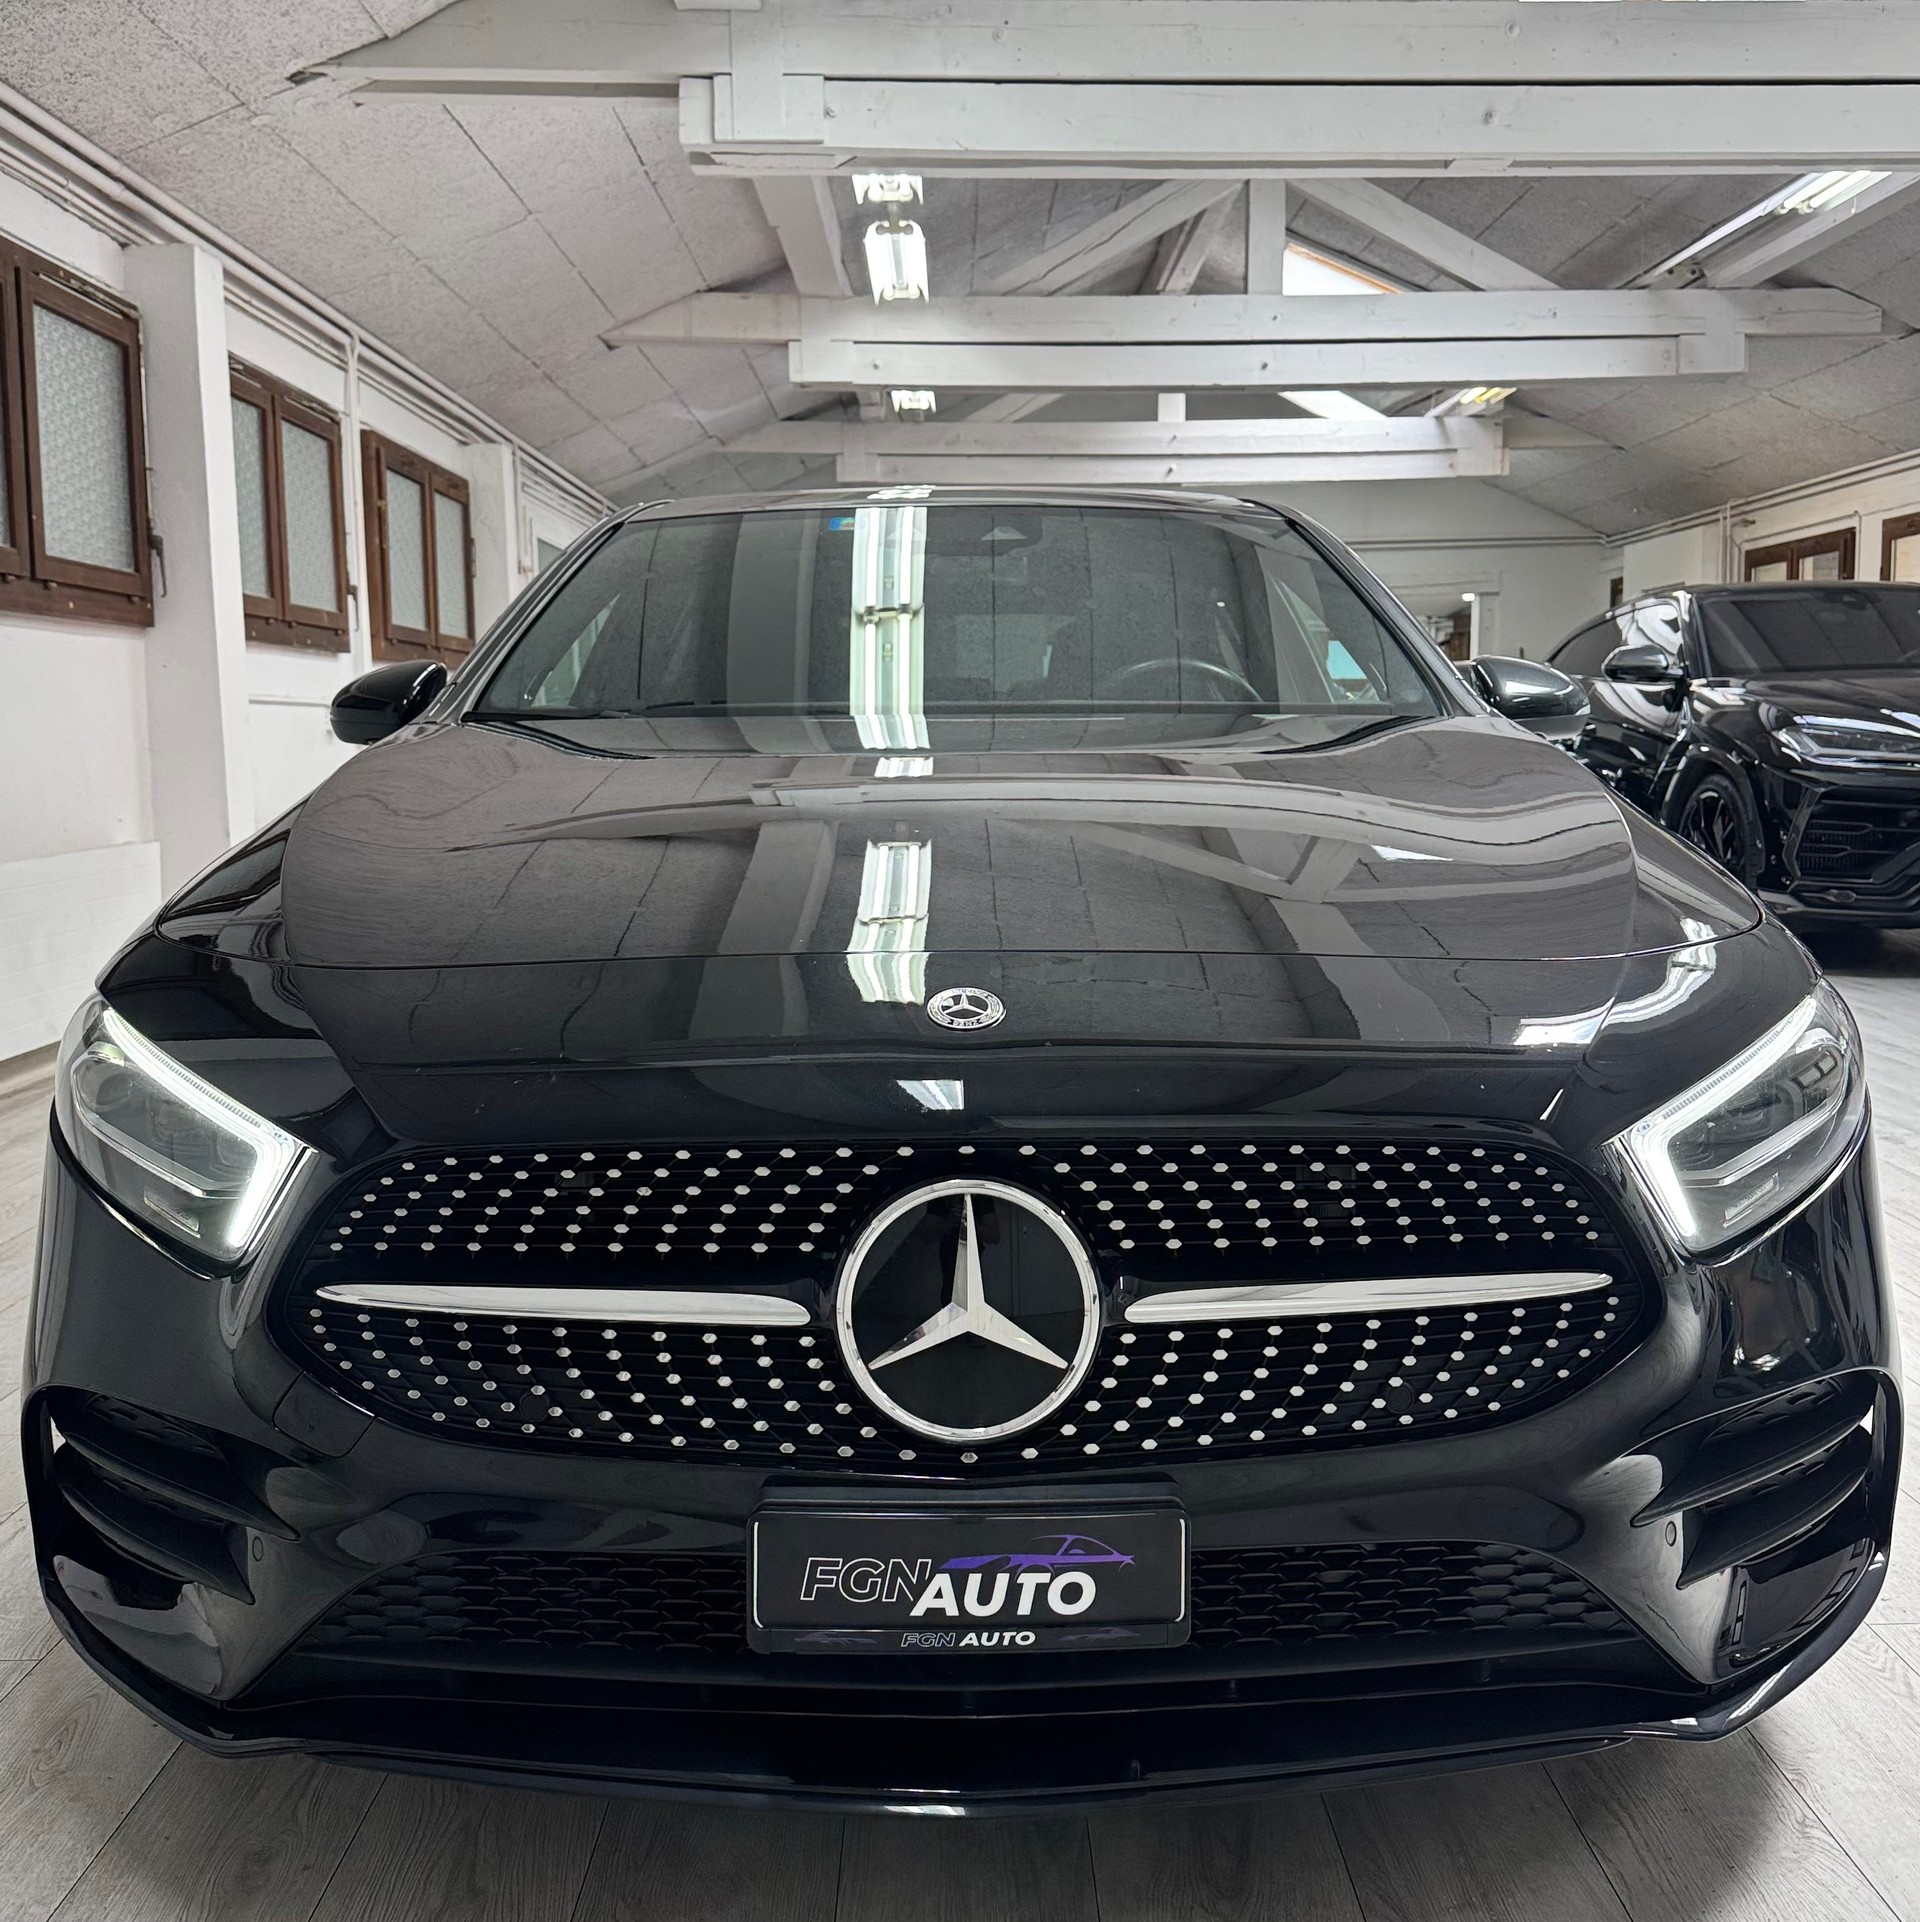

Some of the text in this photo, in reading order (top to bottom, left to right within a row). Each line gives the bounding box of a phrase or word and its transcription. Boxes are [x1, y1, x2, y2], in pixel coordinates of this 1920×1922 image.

[800, 1557, 1097, 1617] FGN AUTO
[901, 1631, 1036, 1647] FGN AUTO
